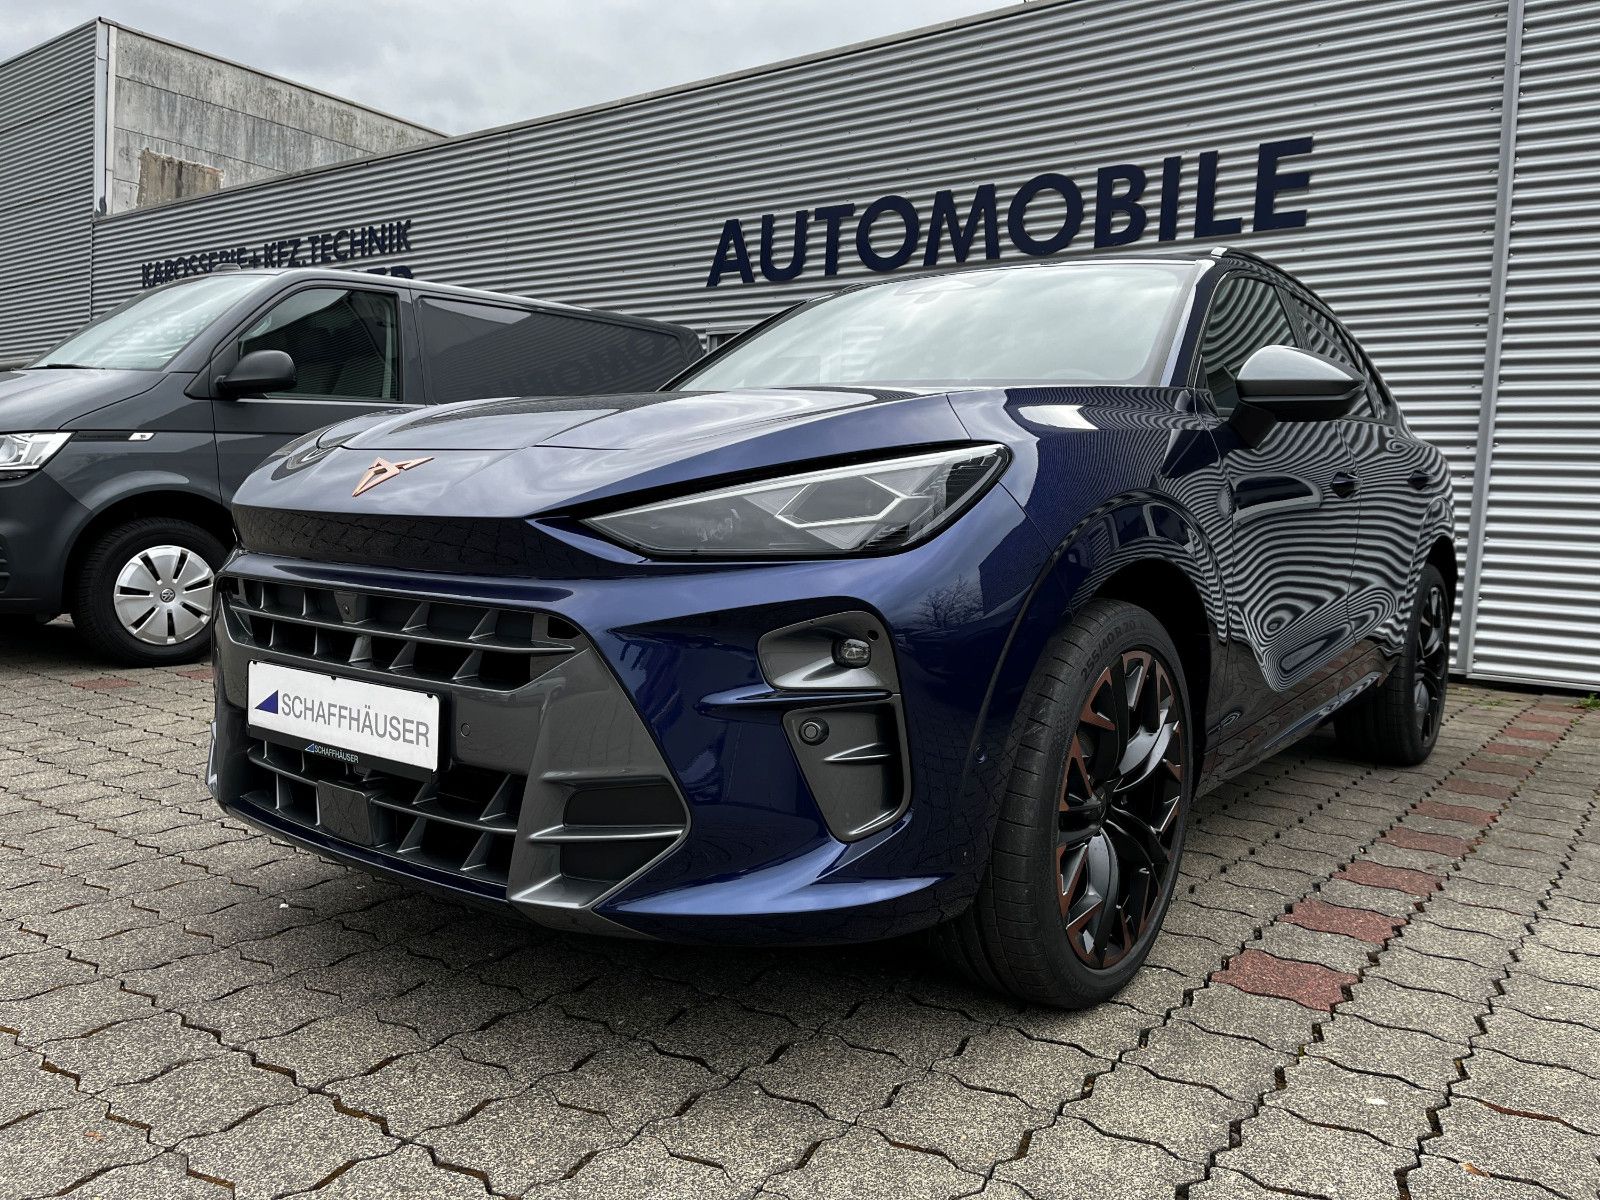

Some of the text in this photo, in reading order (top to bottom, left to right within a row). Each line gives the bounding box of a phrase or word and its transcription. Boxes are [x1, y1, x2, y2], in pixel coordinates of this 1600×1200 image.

[707, 137, 1313, 286] AUTOMOBILE
[281, 693, 430, 747] SCHAFFHÄUSER
[314, 744, 359, 763] SCHAFFHÄUSER
